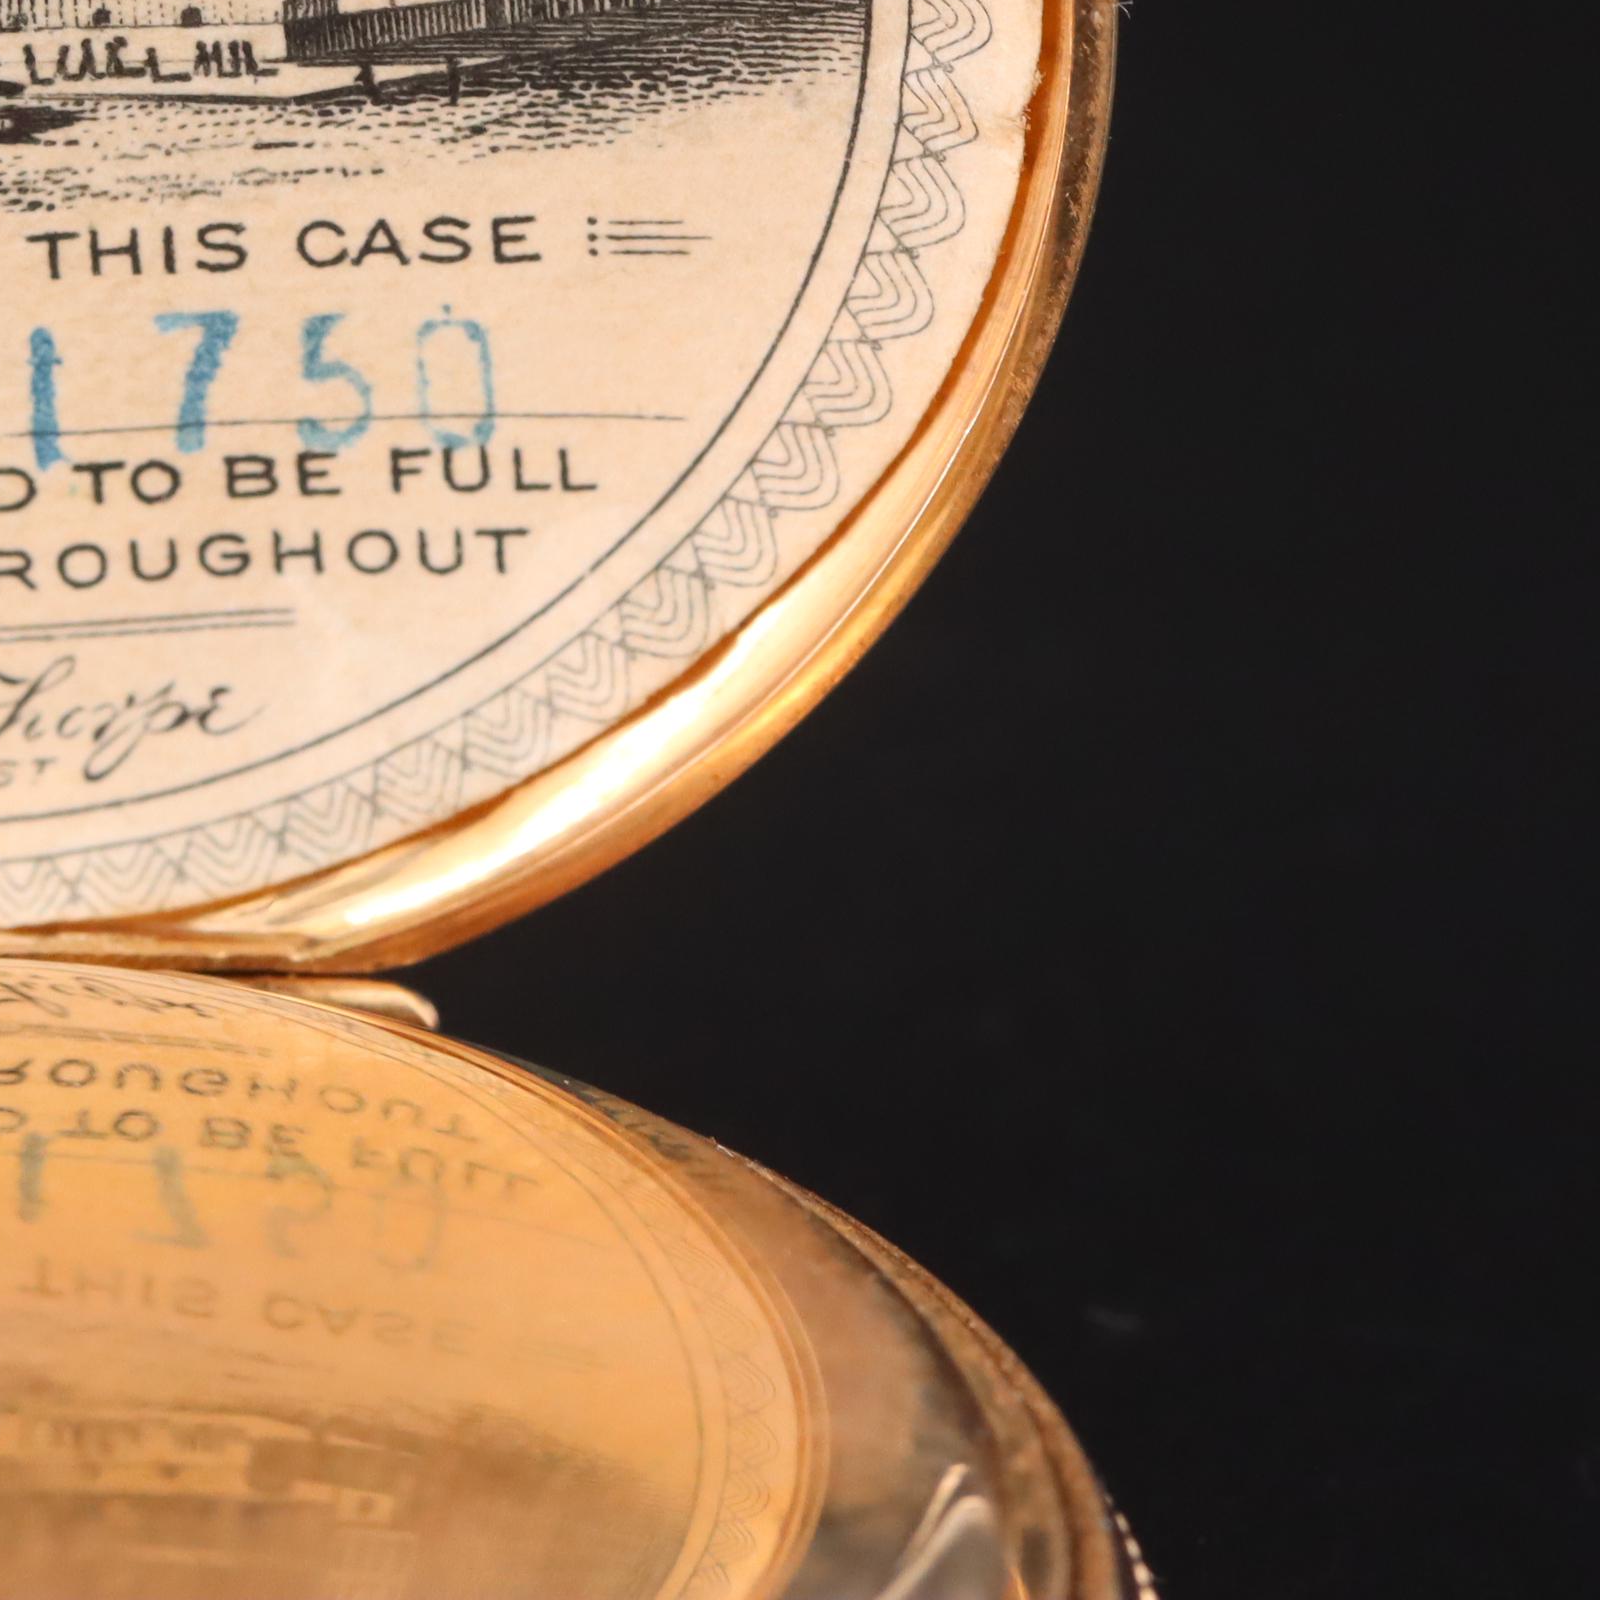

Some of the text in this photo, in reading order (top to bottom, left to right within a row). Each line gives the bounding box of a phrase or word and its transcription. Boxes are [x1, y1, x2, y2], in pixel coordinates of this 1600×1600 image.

[26, 222, 248, 281] THIS
[296, 215, 541, 268] CASE
[72, 459, 181, 505] TO
[225, 451, 341, 498] BE
[390, 444, 599, 494] FULL
